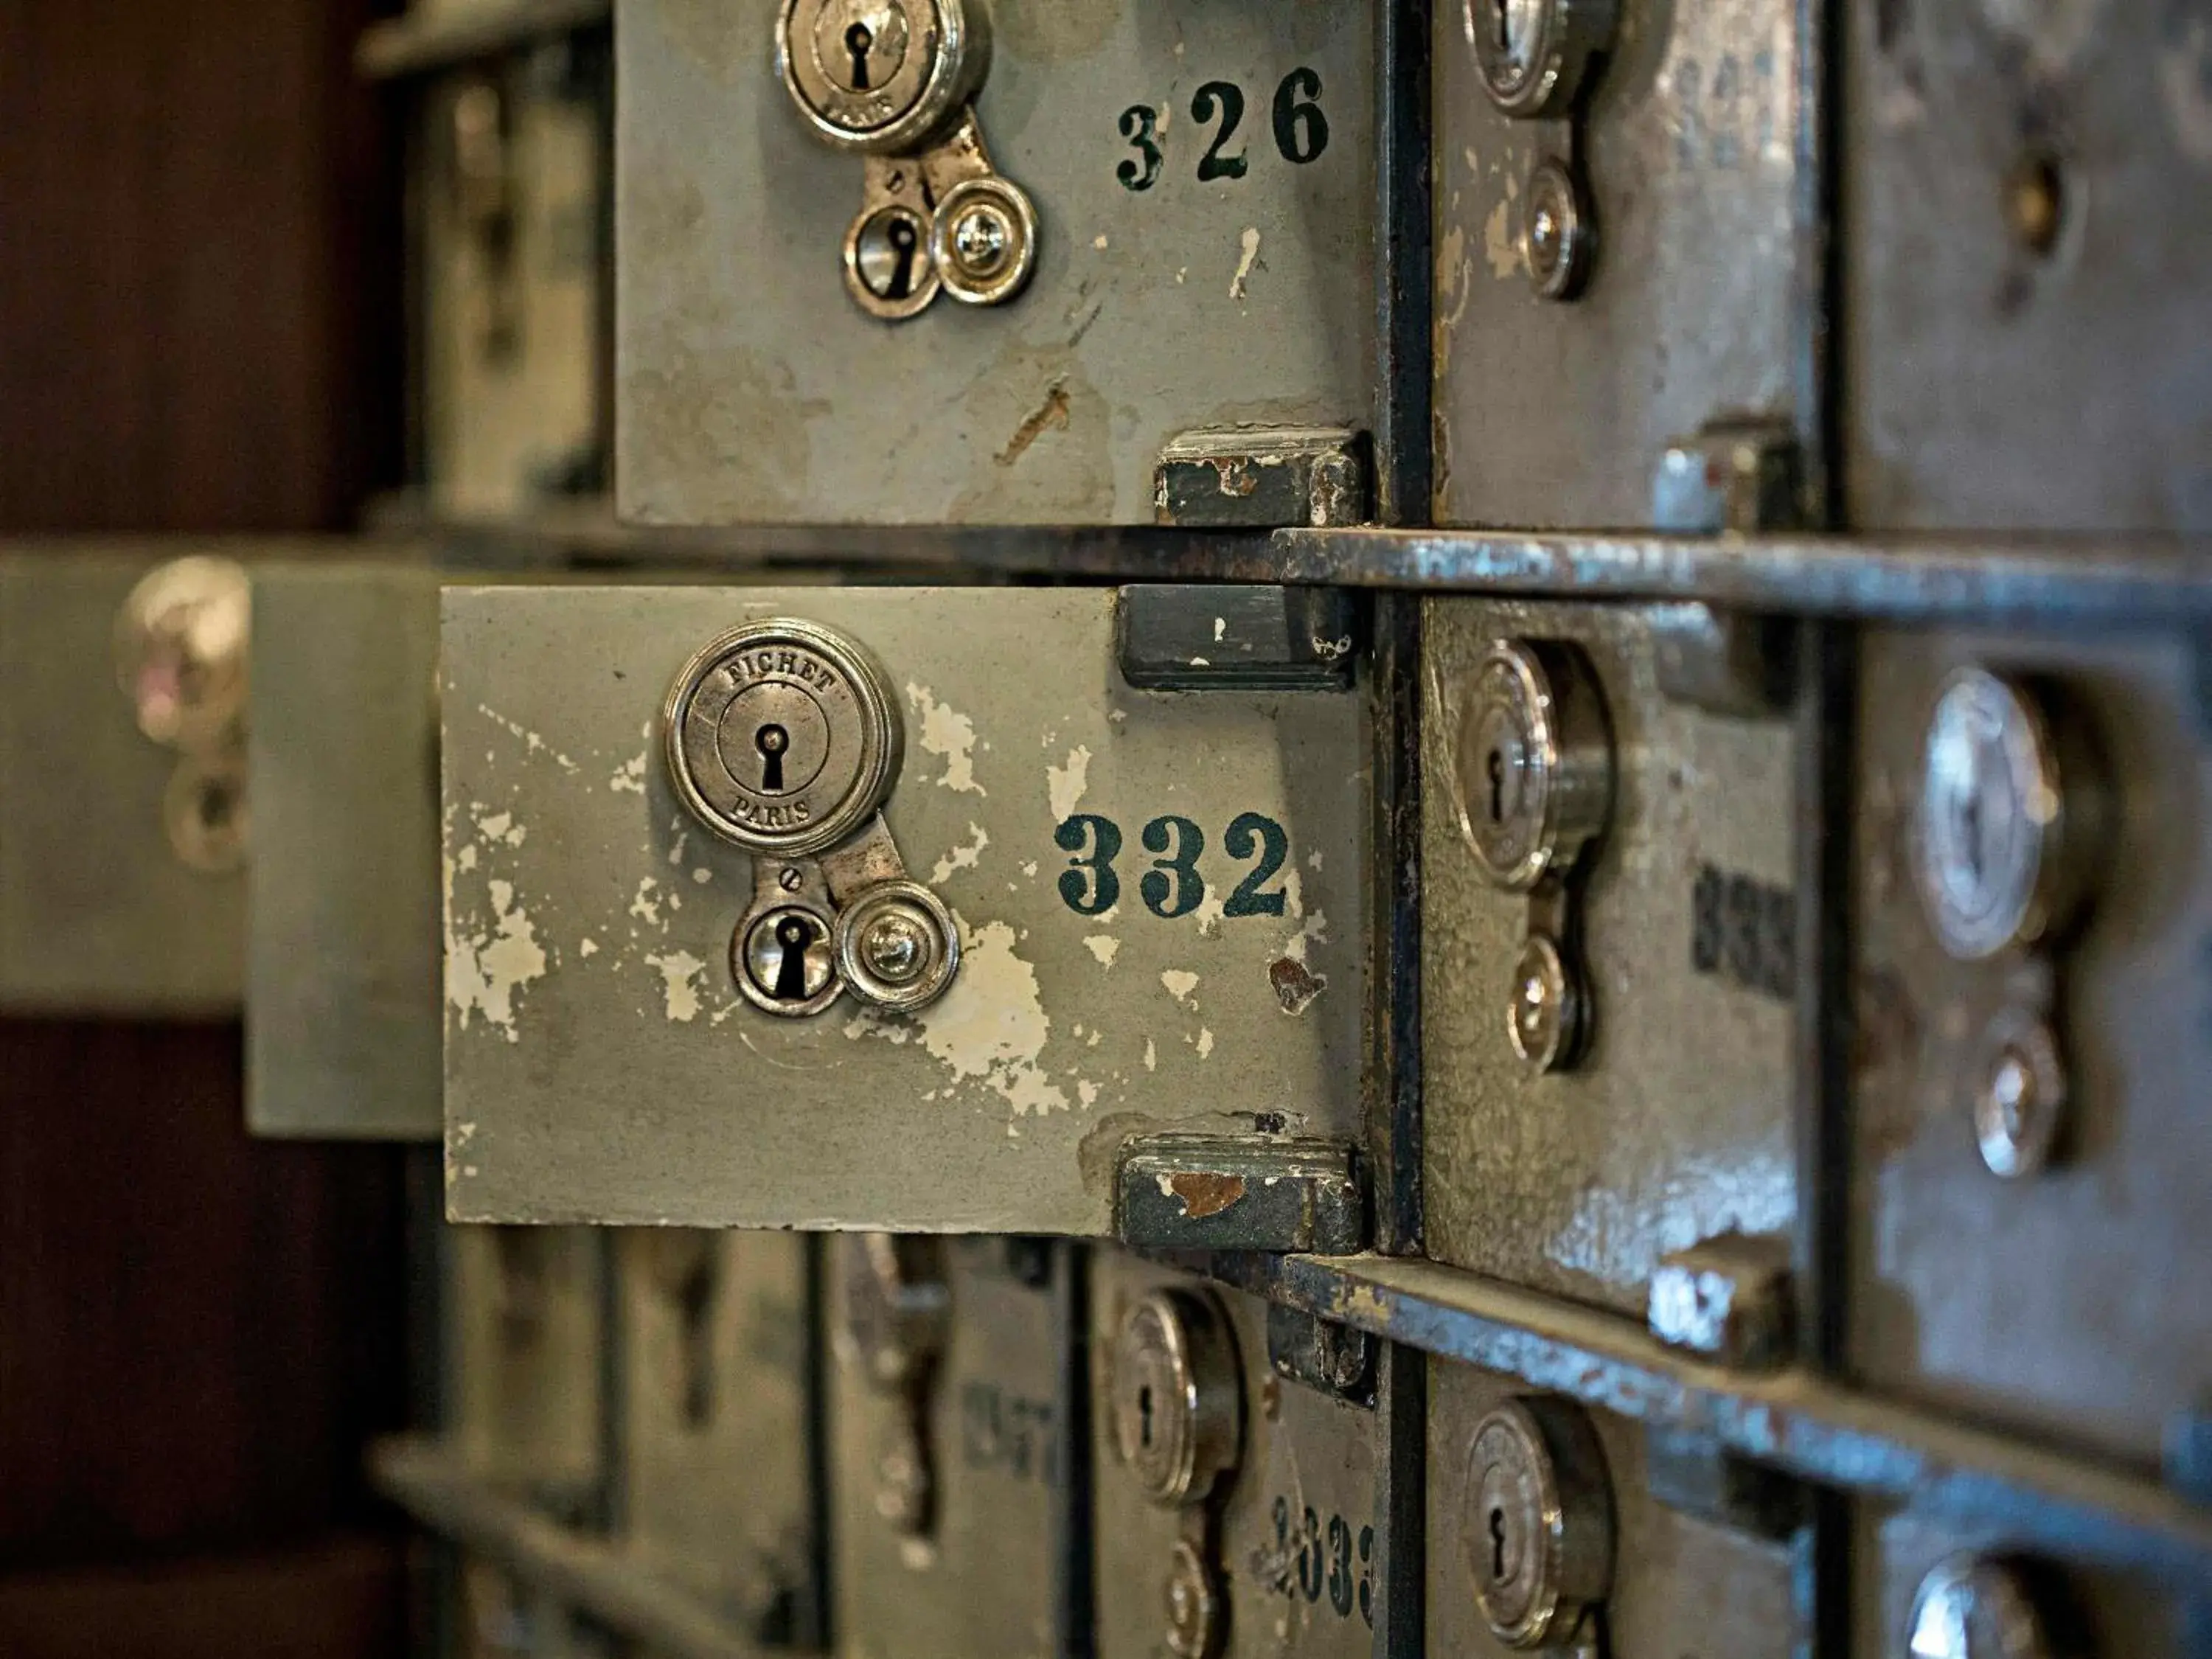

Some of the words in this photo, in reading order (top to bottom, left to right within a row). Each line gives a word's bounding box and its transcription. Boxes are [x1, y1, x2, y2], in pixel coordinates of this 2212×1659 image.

[1116, 66, 1329, 191] 326
[723, 652, 837, 693] FICHET
[731, 796, 812, 827] PARIS
[1053, 812, 1289, 918] 332
